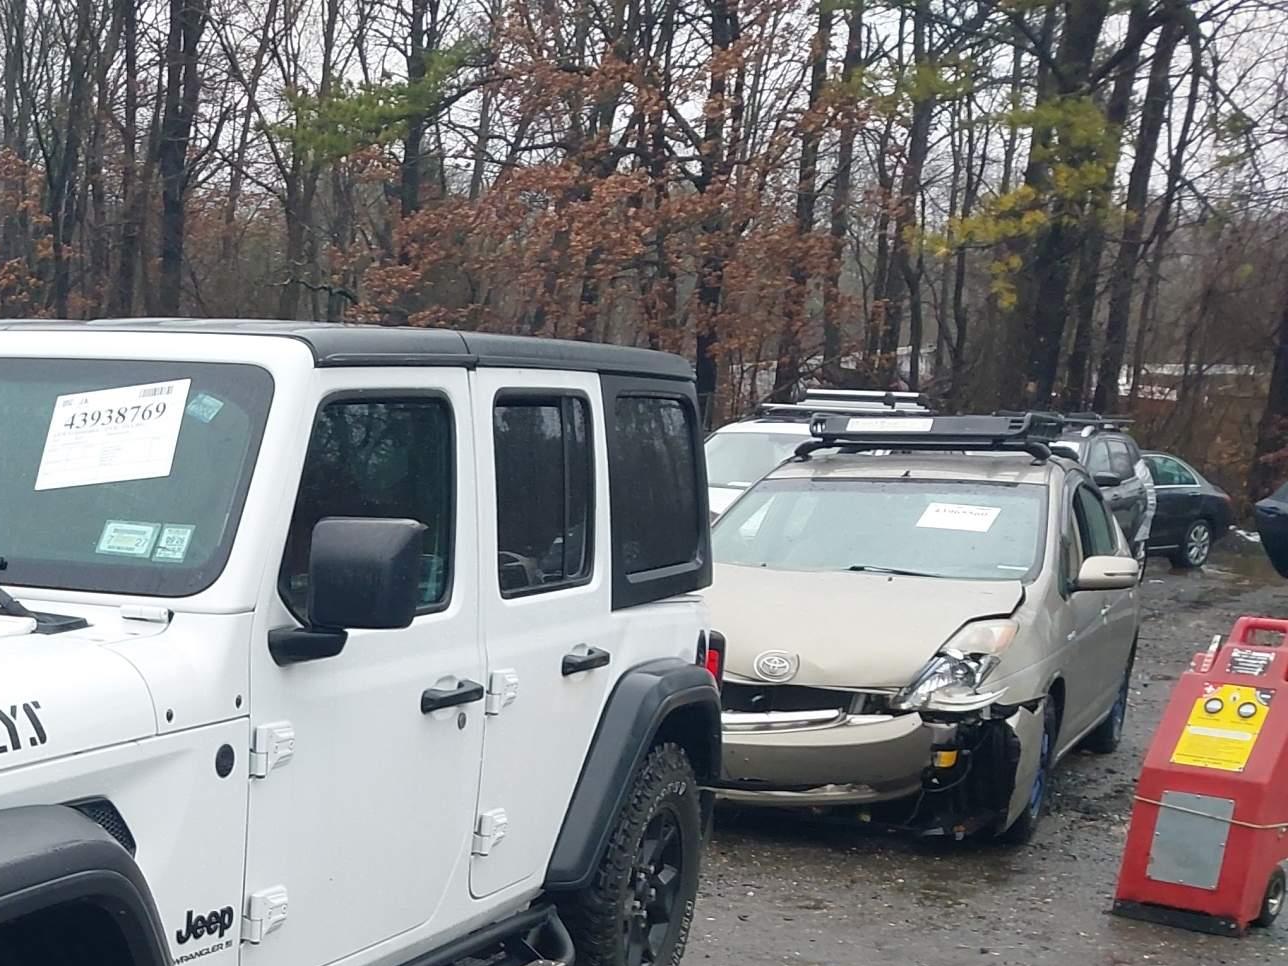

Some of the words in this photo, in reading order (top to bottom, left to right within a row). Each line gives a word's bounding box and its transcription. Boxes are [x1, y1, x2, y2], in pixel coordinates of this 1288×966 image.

[64, 401, 168, 430] 43938769
[176, 905, 234, 944] Jeep
[173, 942, 224, 965] WRANGLER
